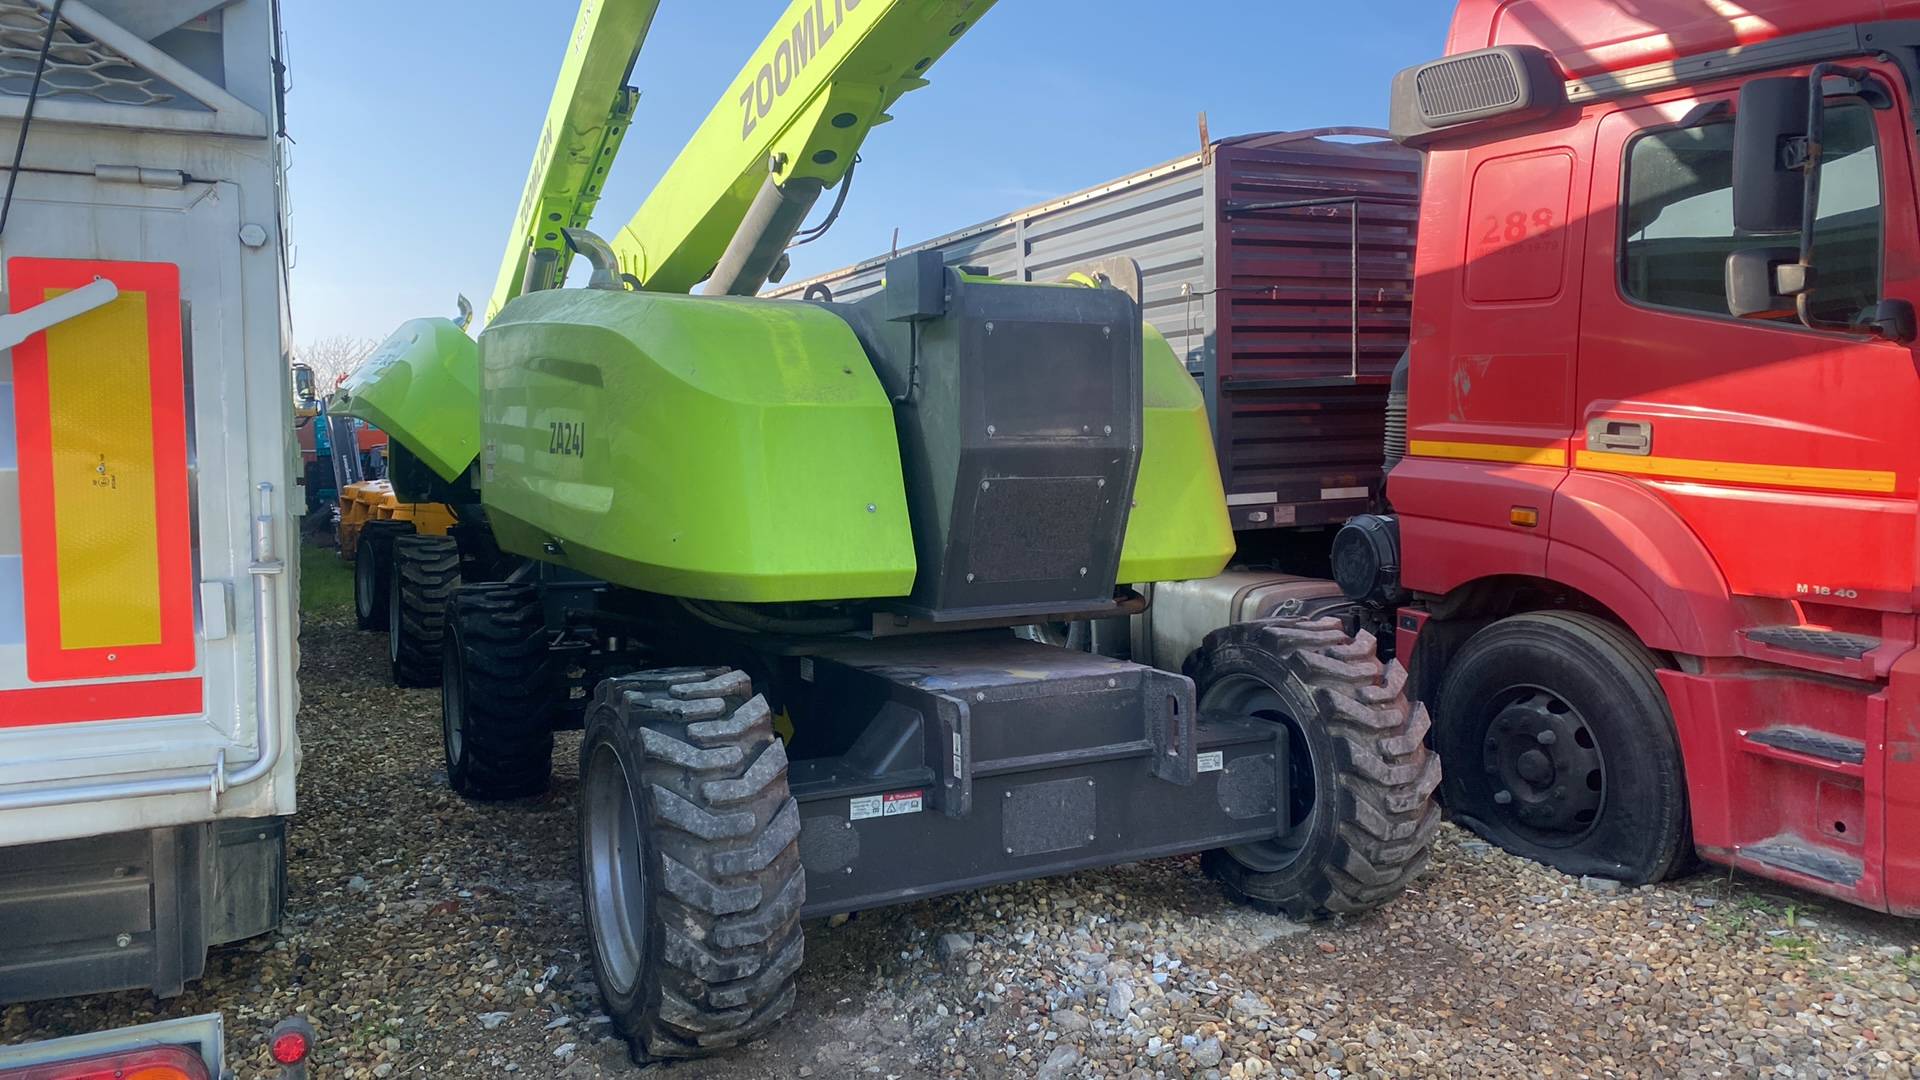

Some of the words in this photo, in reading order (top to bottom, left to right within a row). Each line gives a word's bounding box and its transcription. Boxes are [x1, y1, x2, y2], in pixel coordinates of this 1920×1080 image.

[739, 0, 862, 142] ZOOMLI
[519, 117, 553, 233] ZOOMLION
[549, 421, 585, 459] ZA24J
[1796, 583, 1809, 593] M
[1834, 588, 1857, 599] 40
